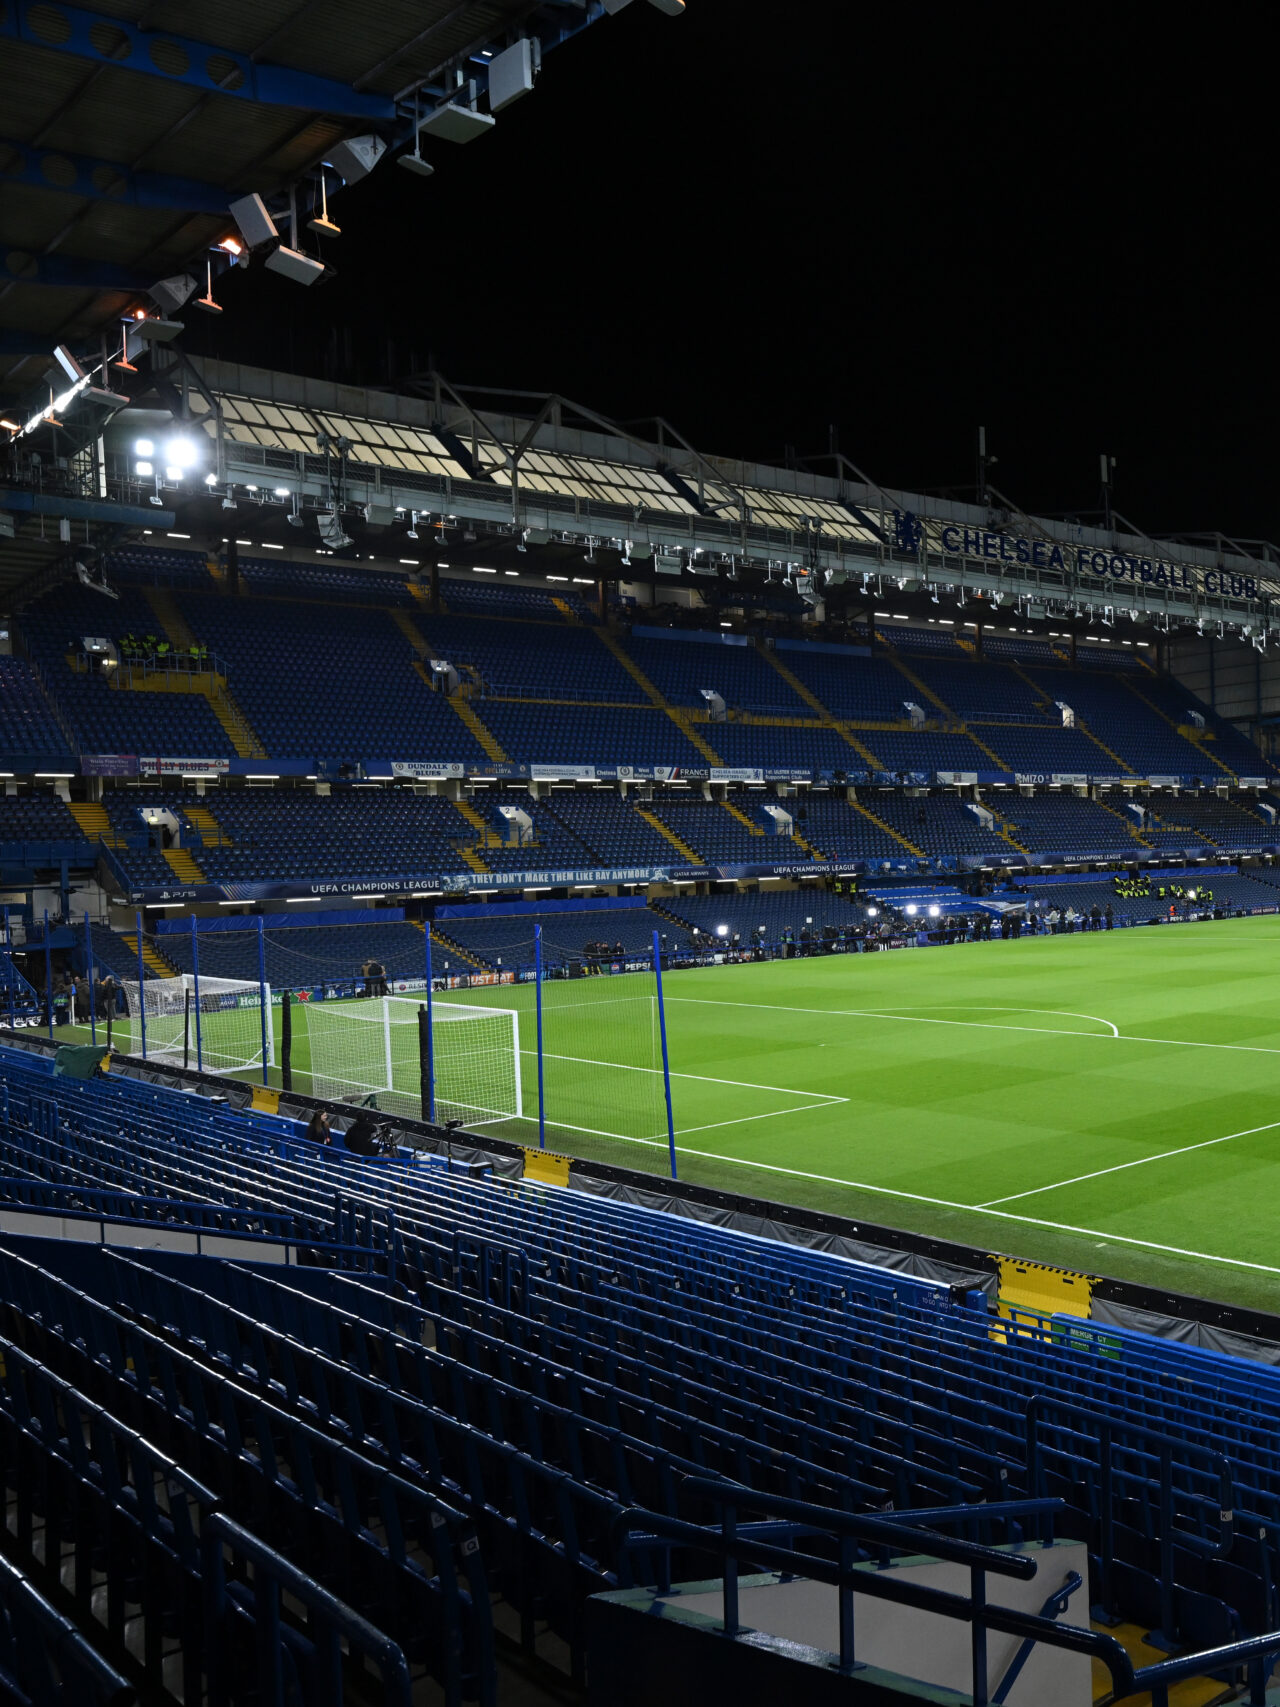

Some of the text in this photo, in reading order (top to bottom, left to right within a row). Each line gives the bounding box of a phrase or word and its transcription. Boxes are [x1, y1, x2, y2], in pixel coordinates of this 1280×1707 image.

[942, 527, 1257, 598] CHELSEA FOOTBALL CLUB
[141, 761, 209, 771] PHILLY BLUES
[680, 768, 709, 776] FRANCE
[793, 865, 830, 873] CHAMPIONS
[472, 869, 650, 884] THEY DON'T MAKE THEM LIKE RAY ANYMORE
[311, 880, 440, 894] UEFA CHAMPIONS LEAGUE
